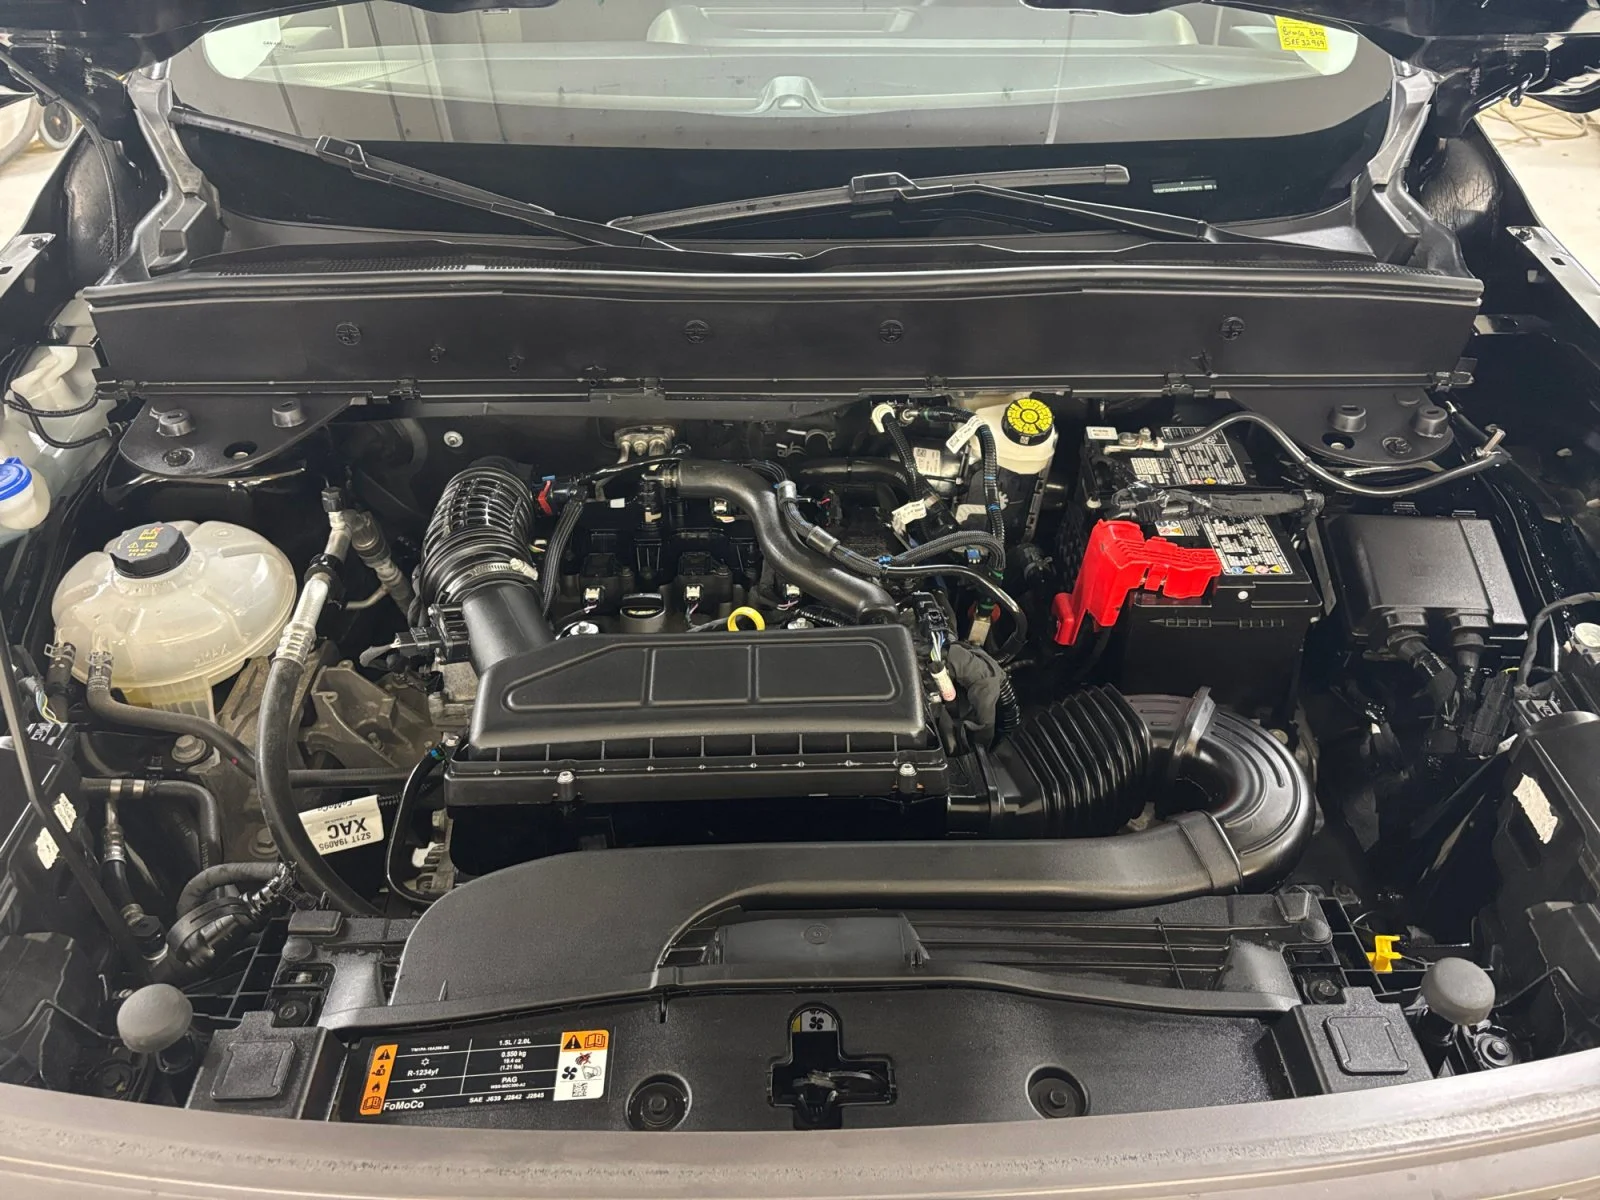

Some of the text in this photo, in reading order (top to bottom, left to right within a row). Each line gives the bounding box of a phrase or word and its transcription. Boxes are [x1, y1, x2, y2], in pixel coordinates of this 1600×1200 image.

[327, 817, 368, 840] XAC
[318, 838, 348, 851] 19A095
[518, 1050, 527, 1058] kg
[407, 1067, 440, 1077] R-1234yf
[383, 1100, 425, 1111] FoMoCo
